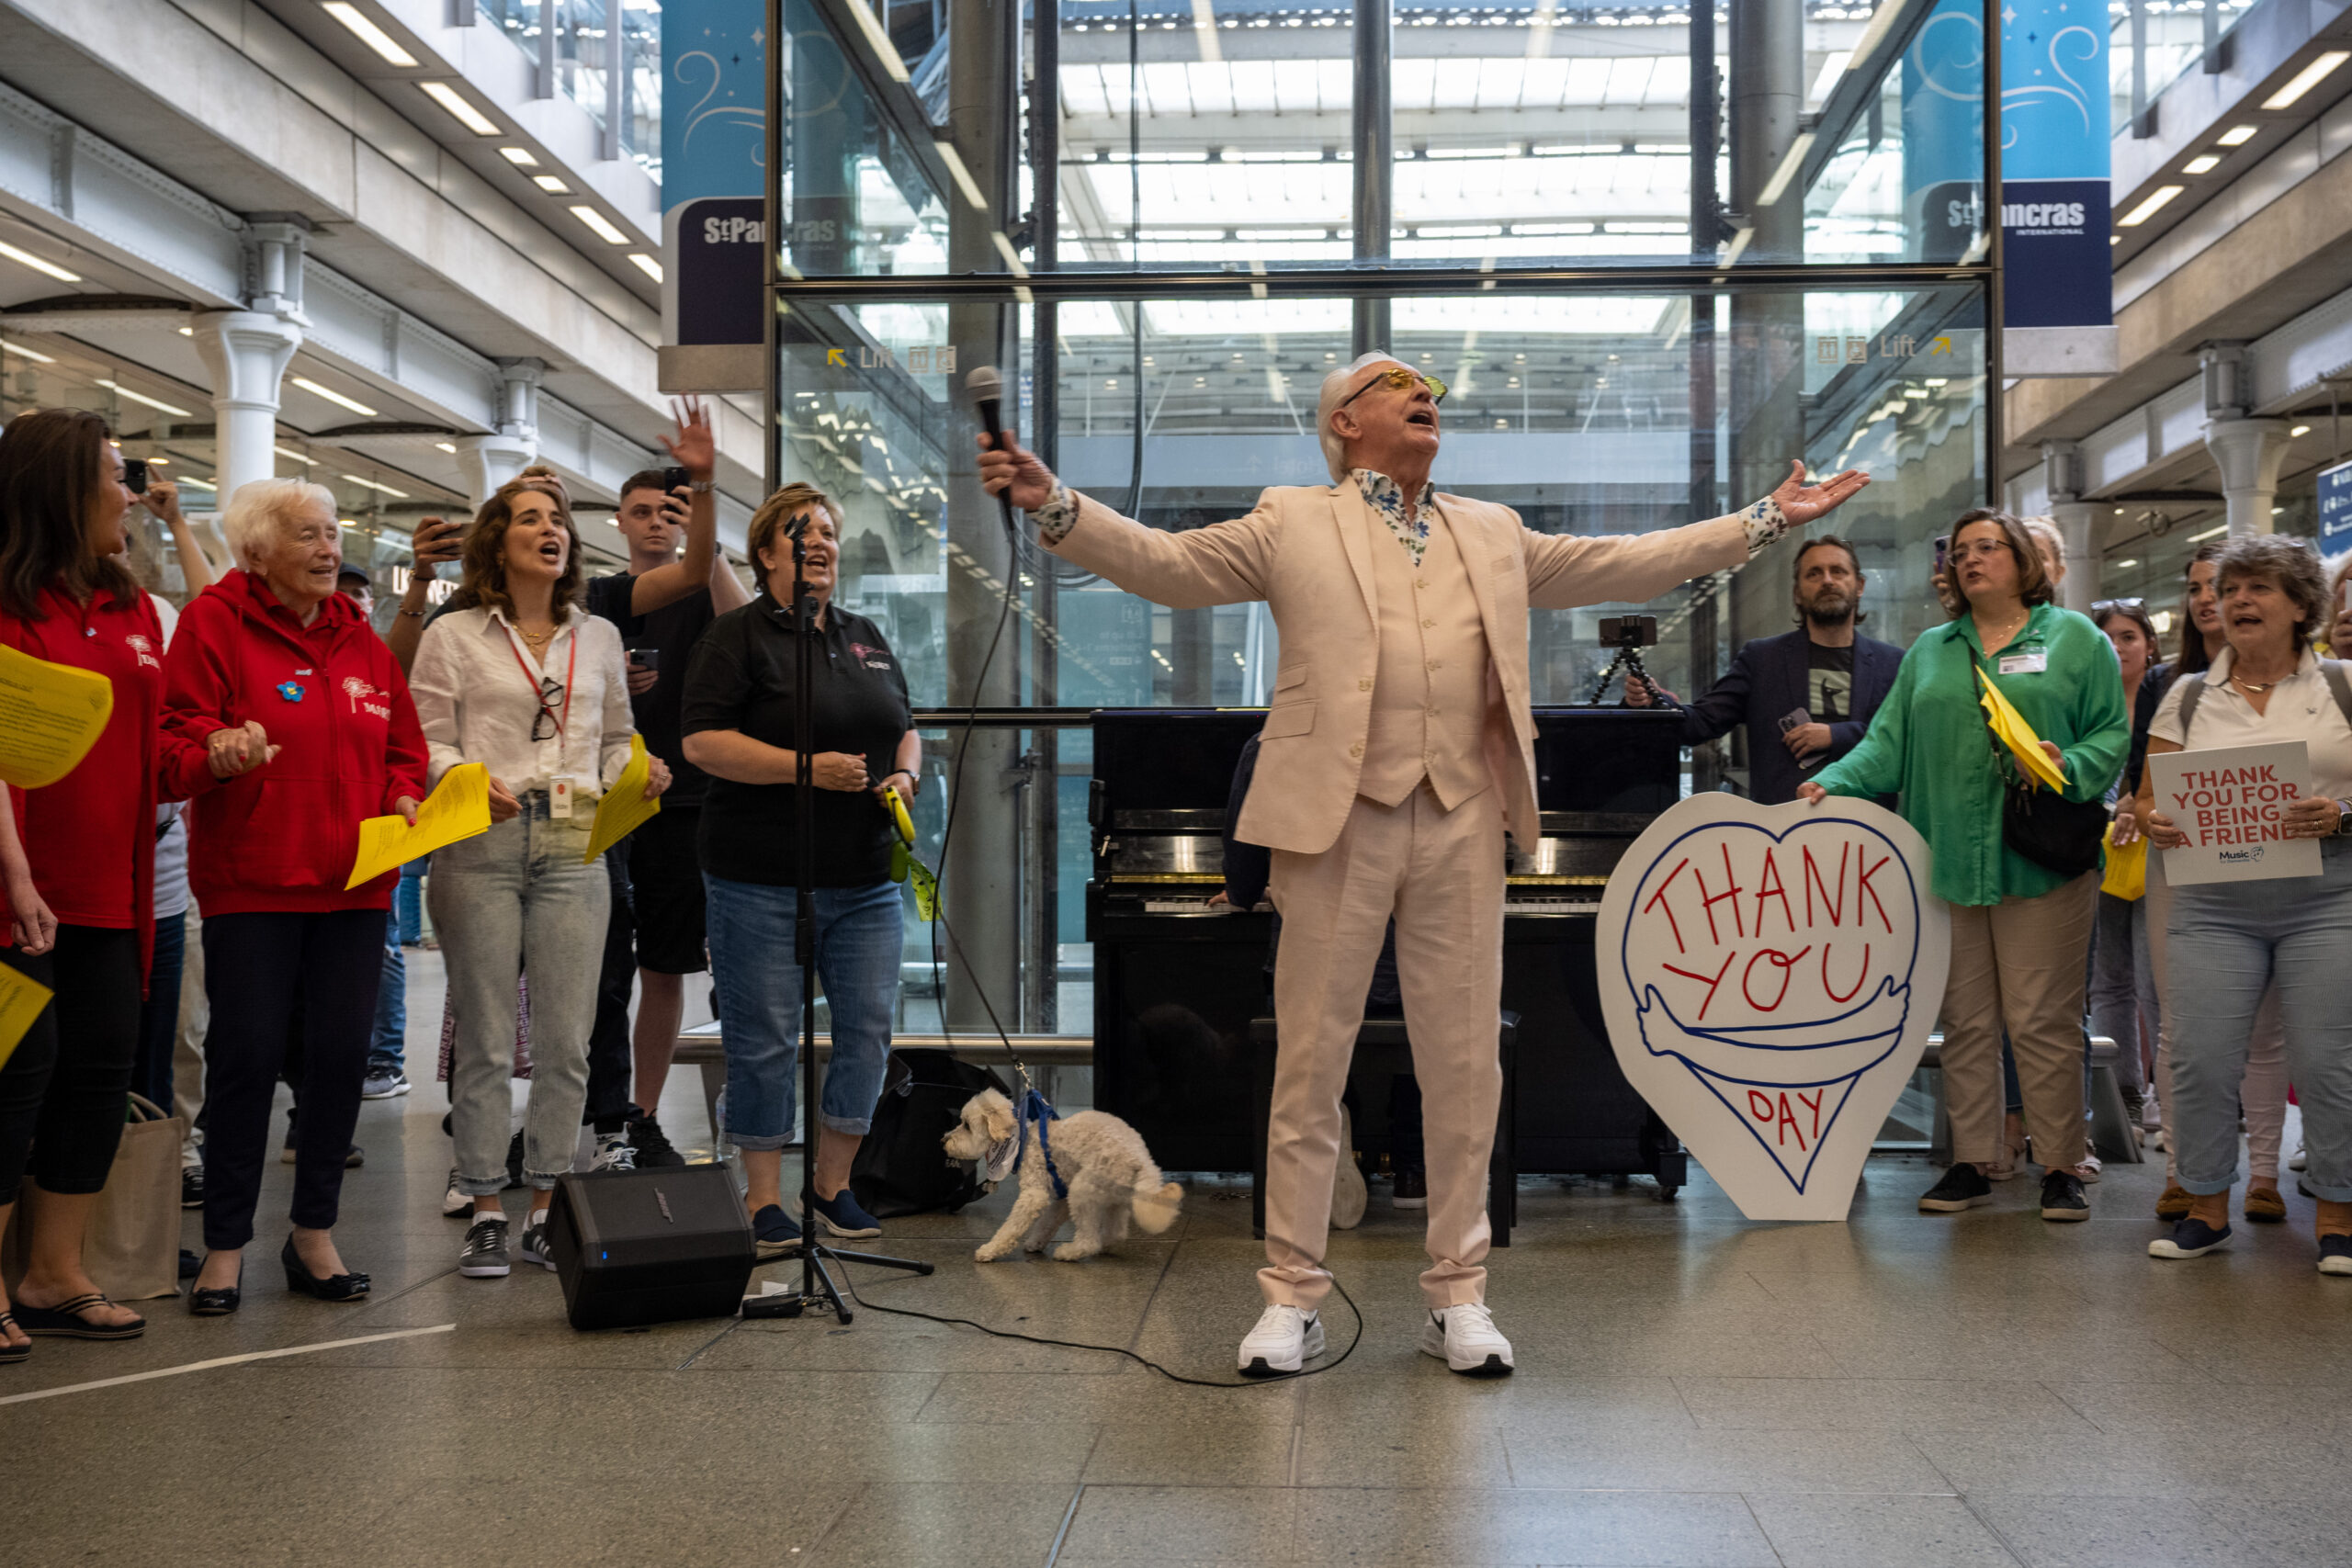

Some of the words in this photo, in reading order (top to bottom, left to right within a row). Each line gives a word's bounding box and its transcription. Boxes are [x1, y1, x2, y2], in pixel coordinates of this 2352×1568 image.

[860, 345, 894, 368] Lift
[1881, 334, 1916, 357] Lift
[2180, 763, 2278, 790] THANK
[2172, 788, 2233, 810] YOU
[2242, 783, 2301, 805] FOR
[2197, 805, 2280, 828] BEING
[2174, 831, 2194, 849] A
[2219, 850, 2250, 860] Music
[1643, 840, 1893, 954] THANK
[1661, 942, 1871, 1021] YOU
[1747, 1089, 1825, 1152] DAY
